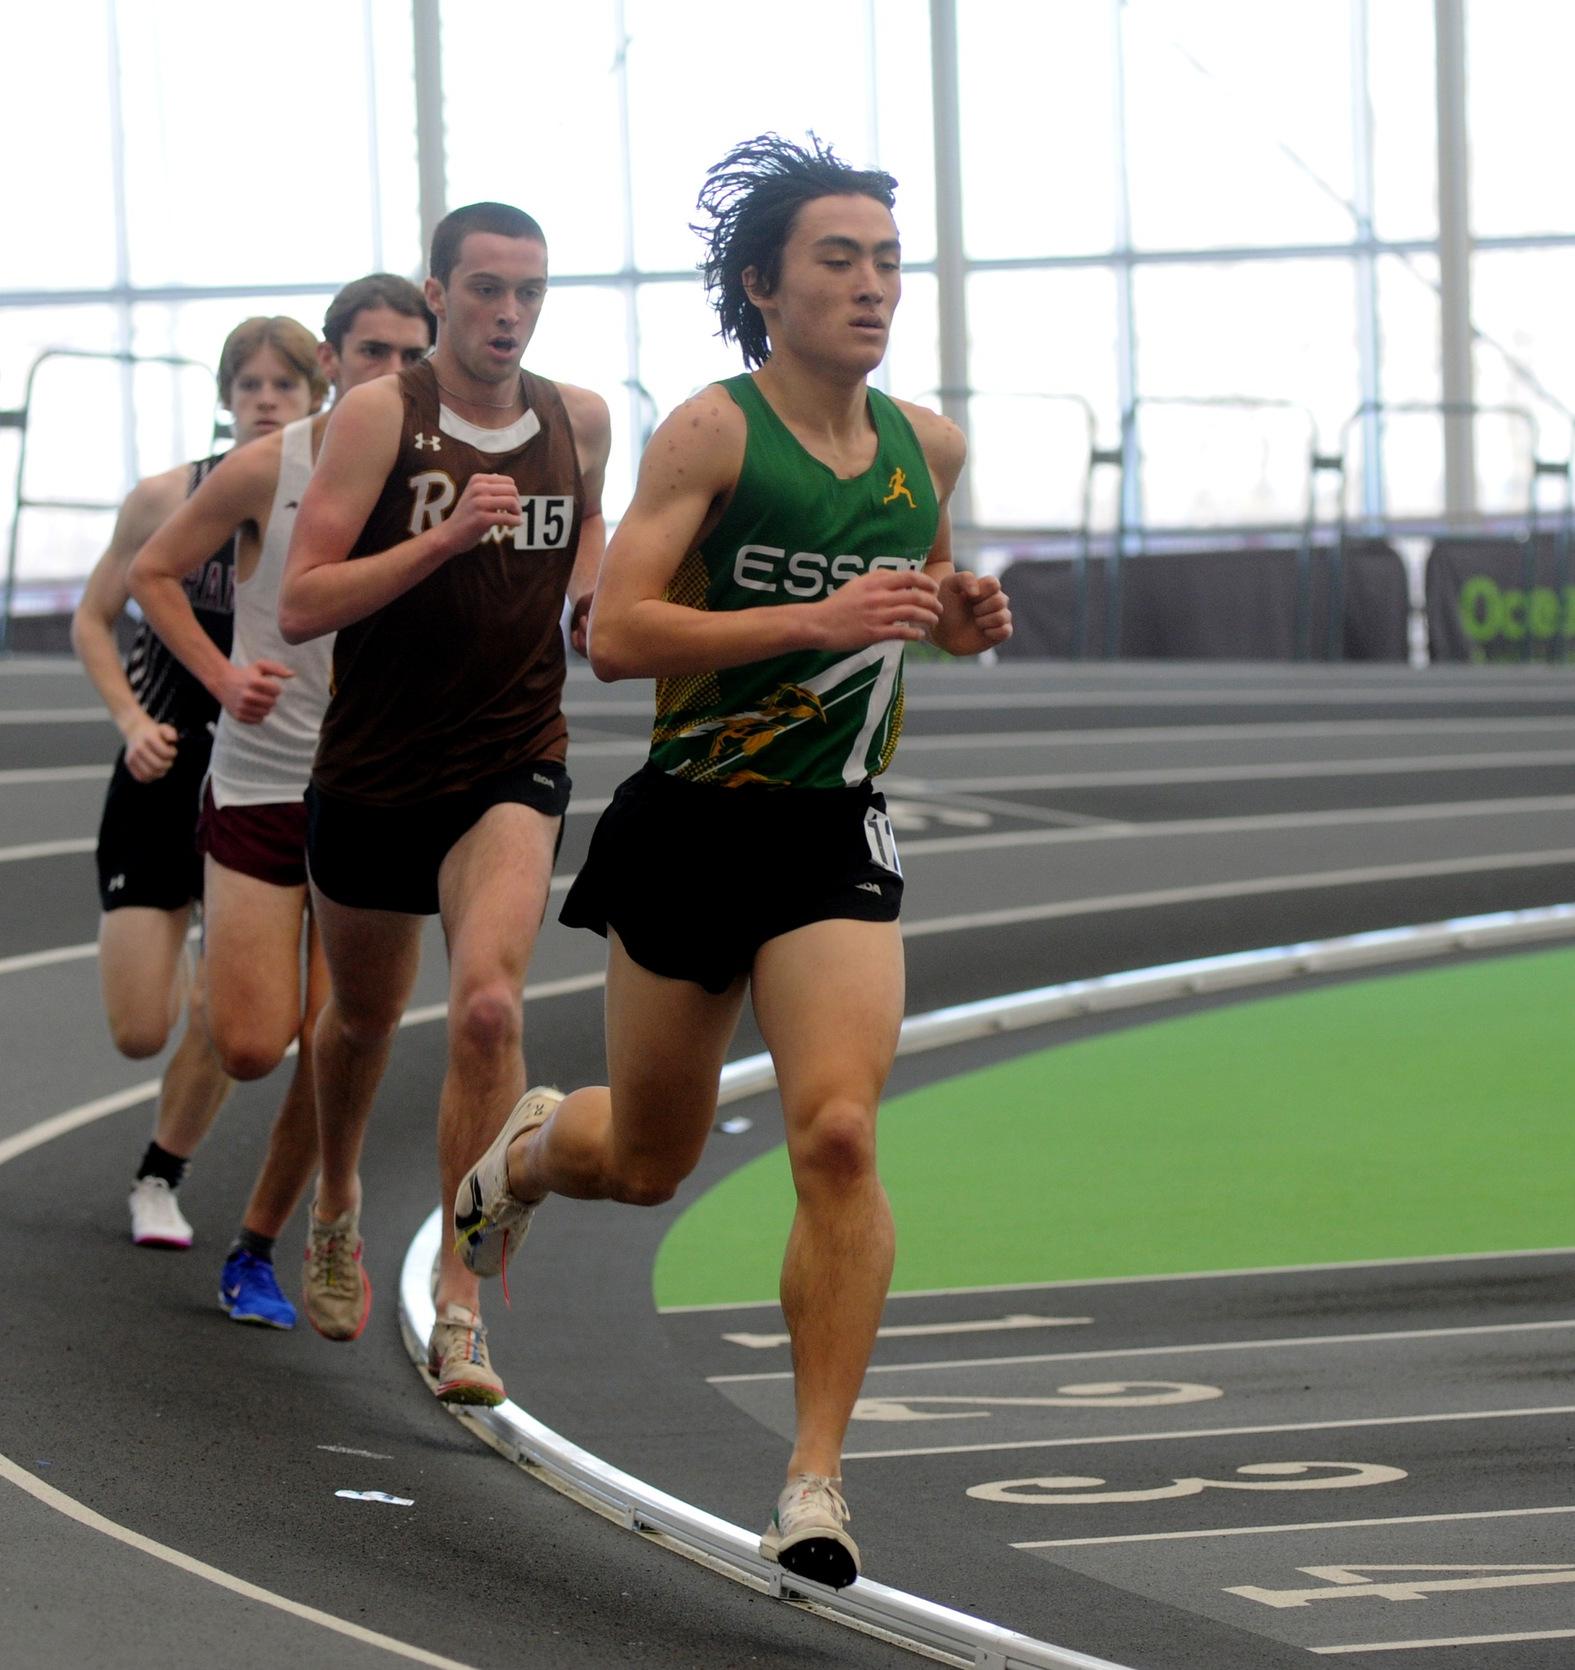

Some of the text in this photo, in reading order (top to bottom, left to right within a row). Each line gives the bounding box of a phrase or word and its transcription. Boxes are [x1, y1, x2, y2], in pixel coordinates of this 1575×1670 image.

[522, 499, 565, 547] 15
[733, 544, 908, 597] ESS
[965, 1460, 1409, 1505] 3
